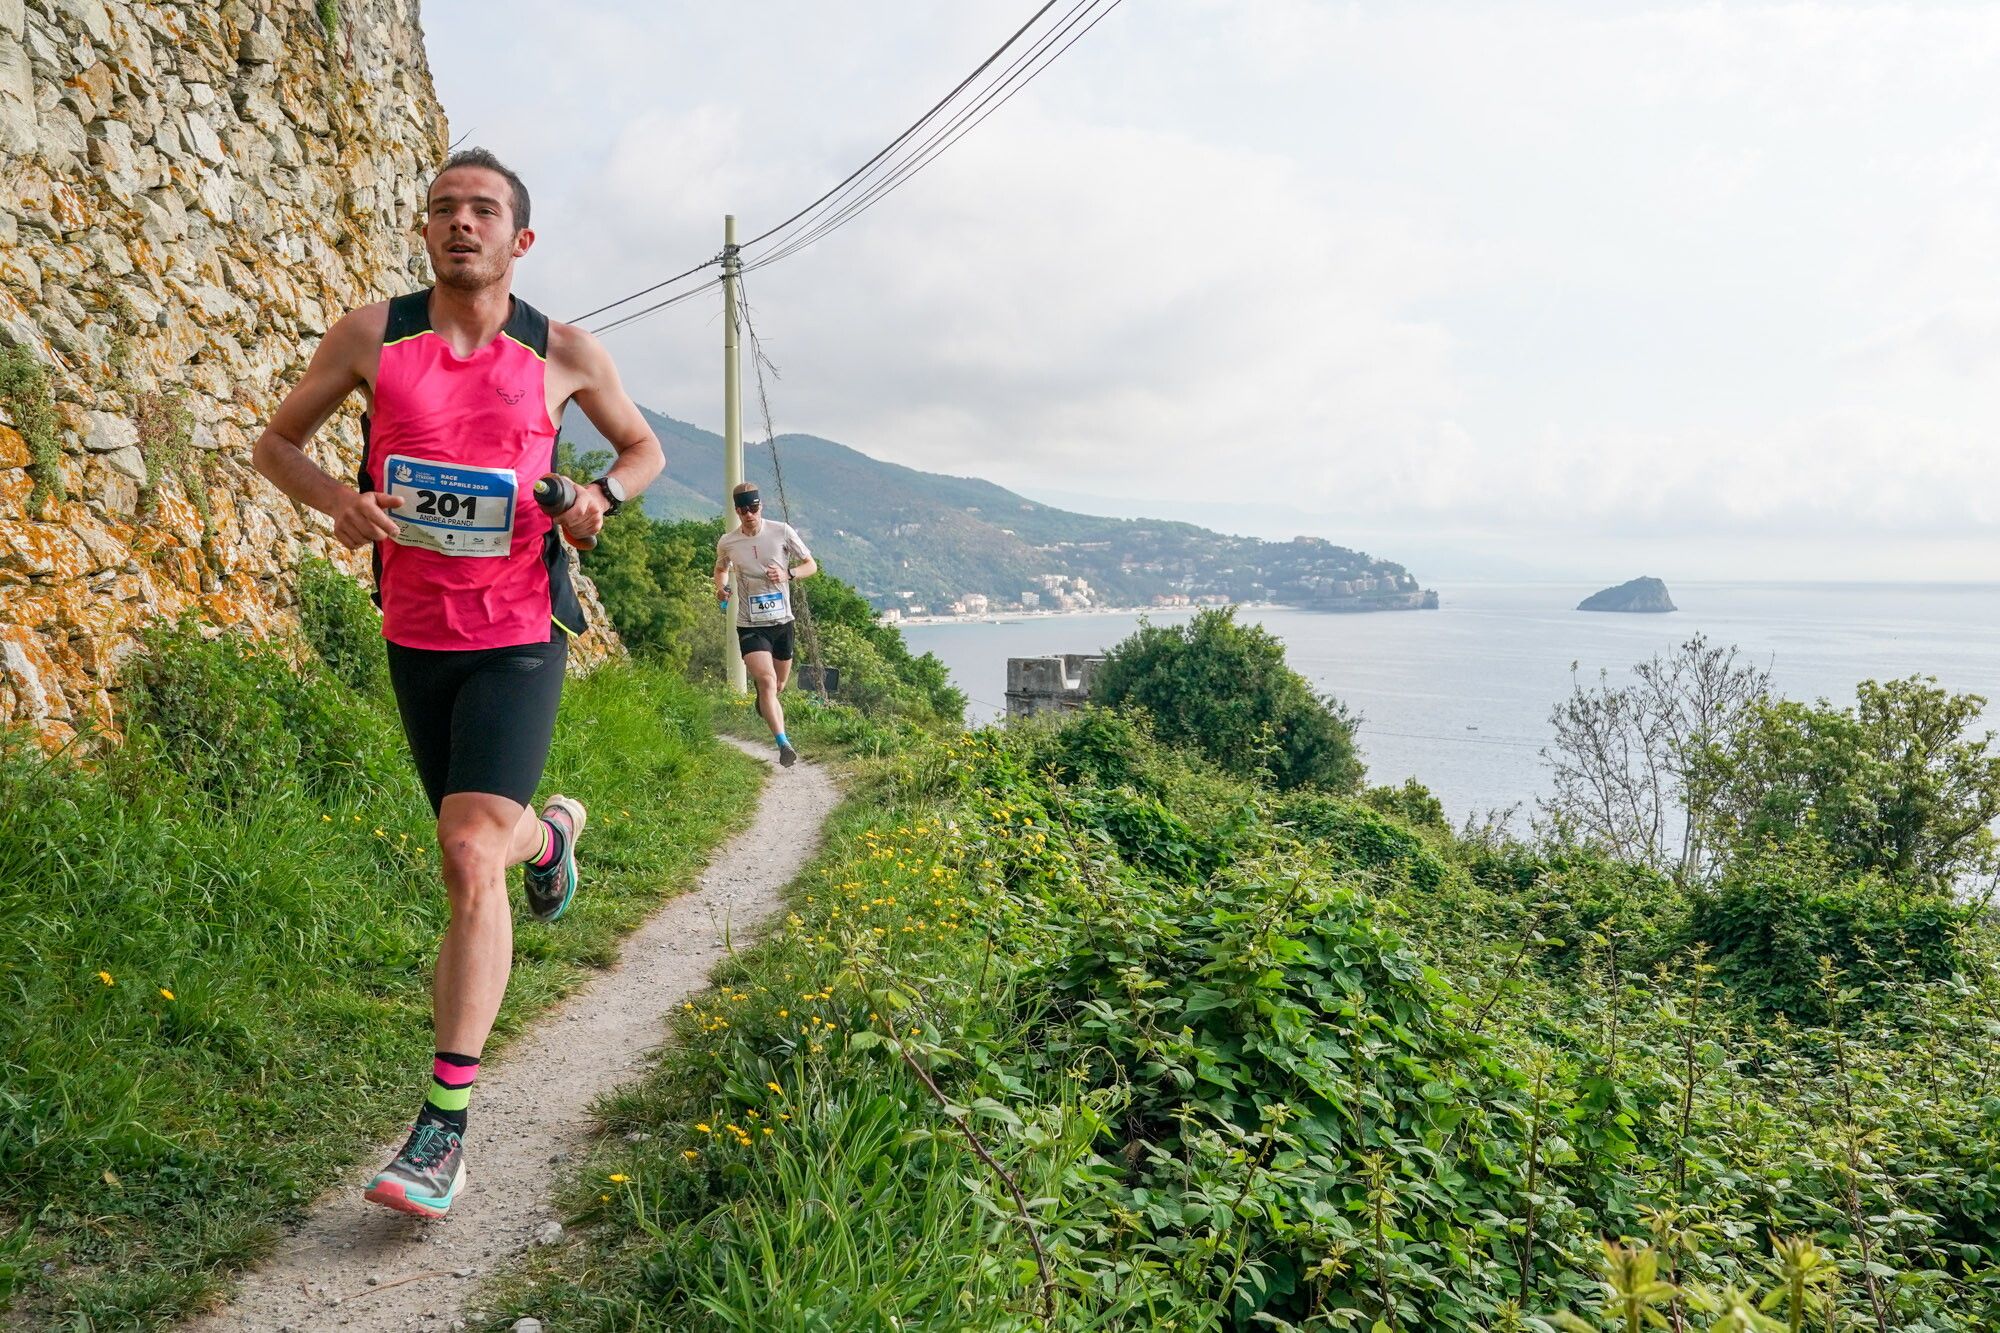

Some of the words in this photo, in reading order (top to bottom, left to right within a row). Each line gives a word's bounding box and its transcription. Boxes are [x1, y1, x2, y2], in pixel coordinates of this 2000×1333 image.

[448, 481, 471, 489] APRILE
[416, 490, 477, 520] 201
[419, 514, 446, 524] ANDREA
[447, 518, 474, 527] PRANDI
[758, 601, 776, 610] 400
